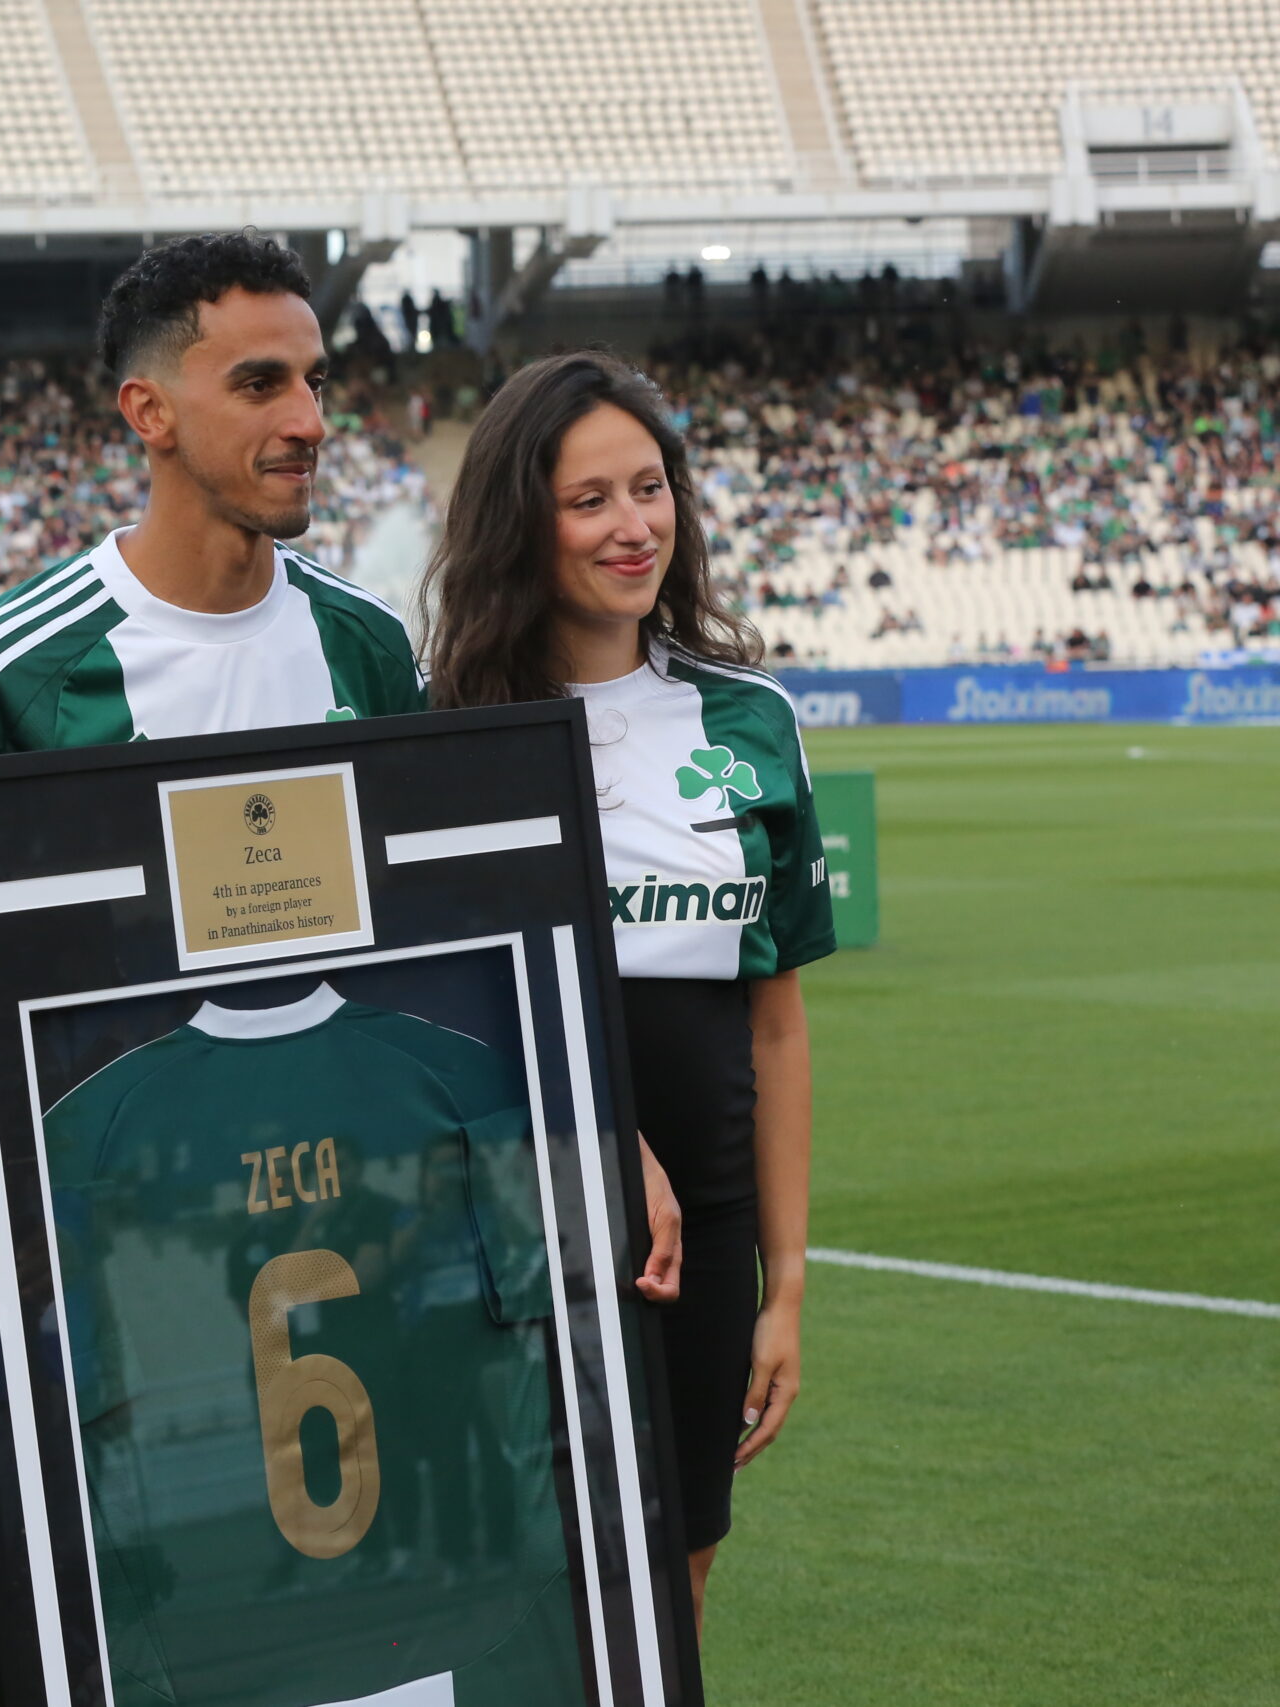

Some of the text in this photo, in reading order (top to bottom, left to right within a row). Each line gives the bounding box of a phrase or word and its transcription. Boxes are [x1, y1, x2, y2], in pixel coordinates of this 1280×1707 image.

[244, 846, 282, 865] Zeca
[213, 875, 322, 899] 4th in appearances
[226, 898, 313, 919] by a foreign player
[208, 914, 335, 940] in Panathinaikos history
[241, 1137, 342, 1215] ZECA
[248, 1248, 381, 1560] 6
